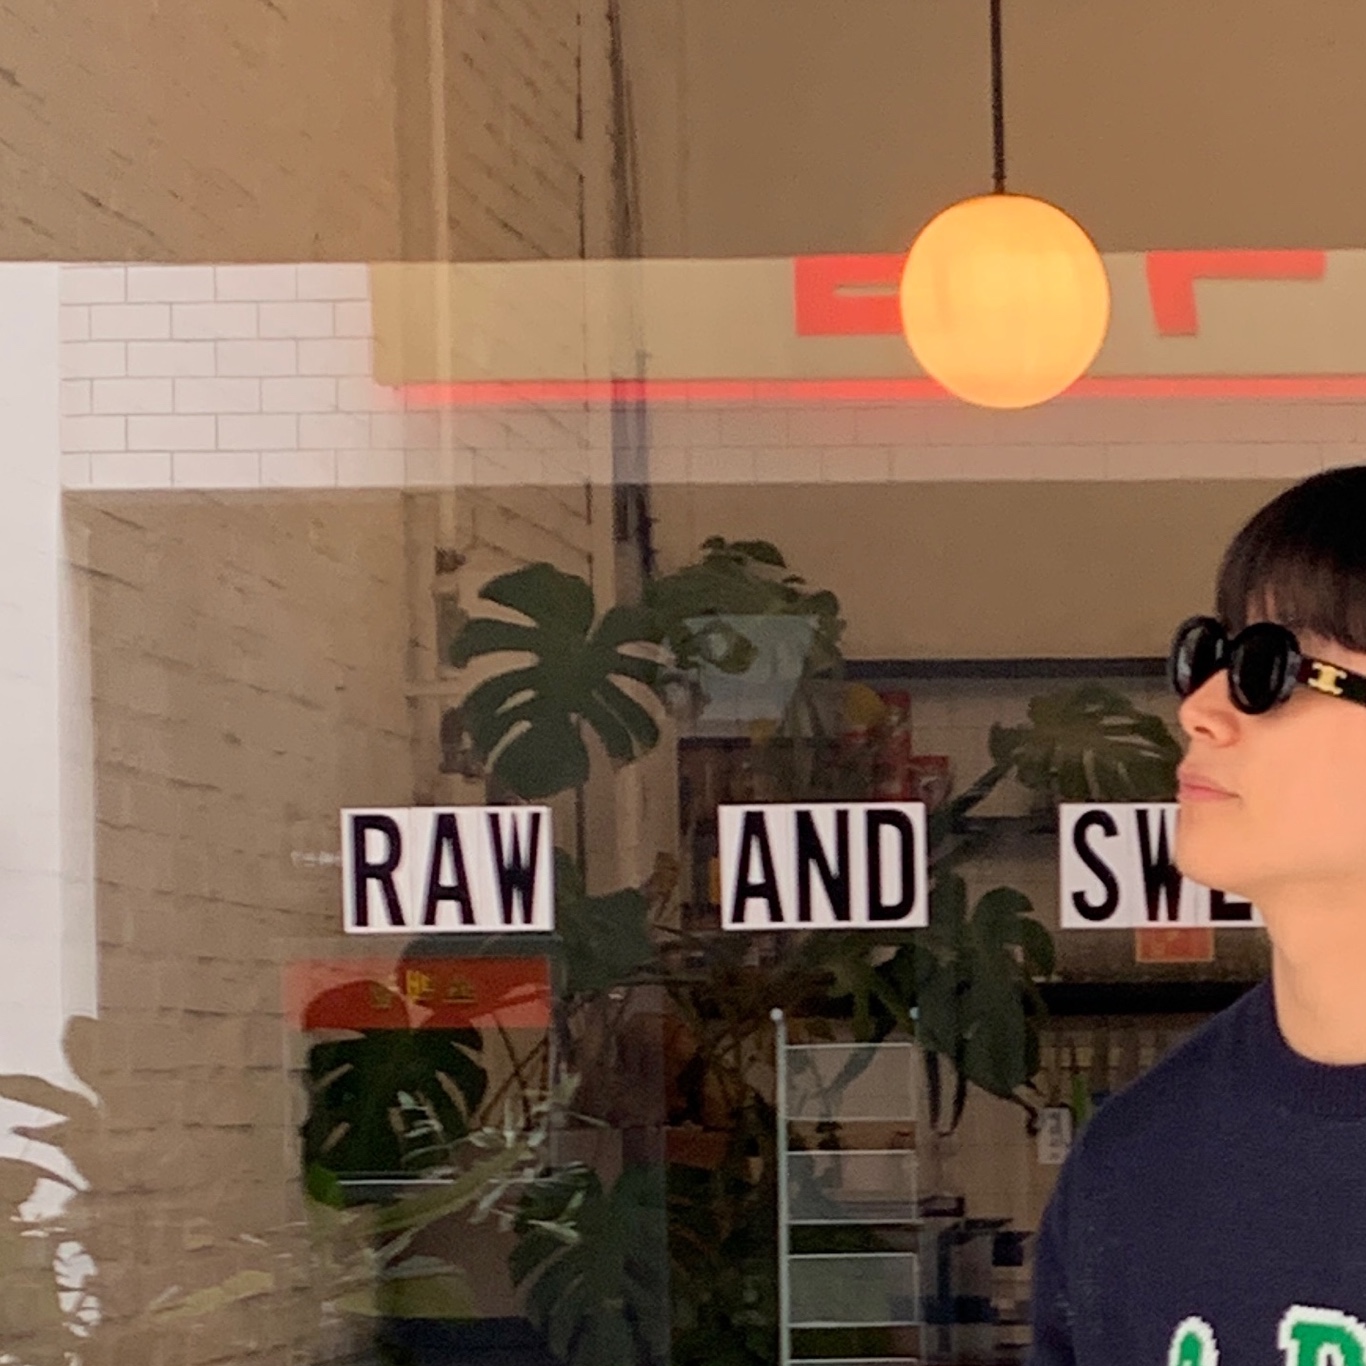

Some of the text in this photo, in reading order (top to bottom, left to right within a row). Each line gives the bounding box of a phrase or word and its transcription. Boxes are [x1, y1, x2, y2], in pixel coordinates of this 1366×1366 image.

[351, 808, 1253, 926] RAW AND SW
